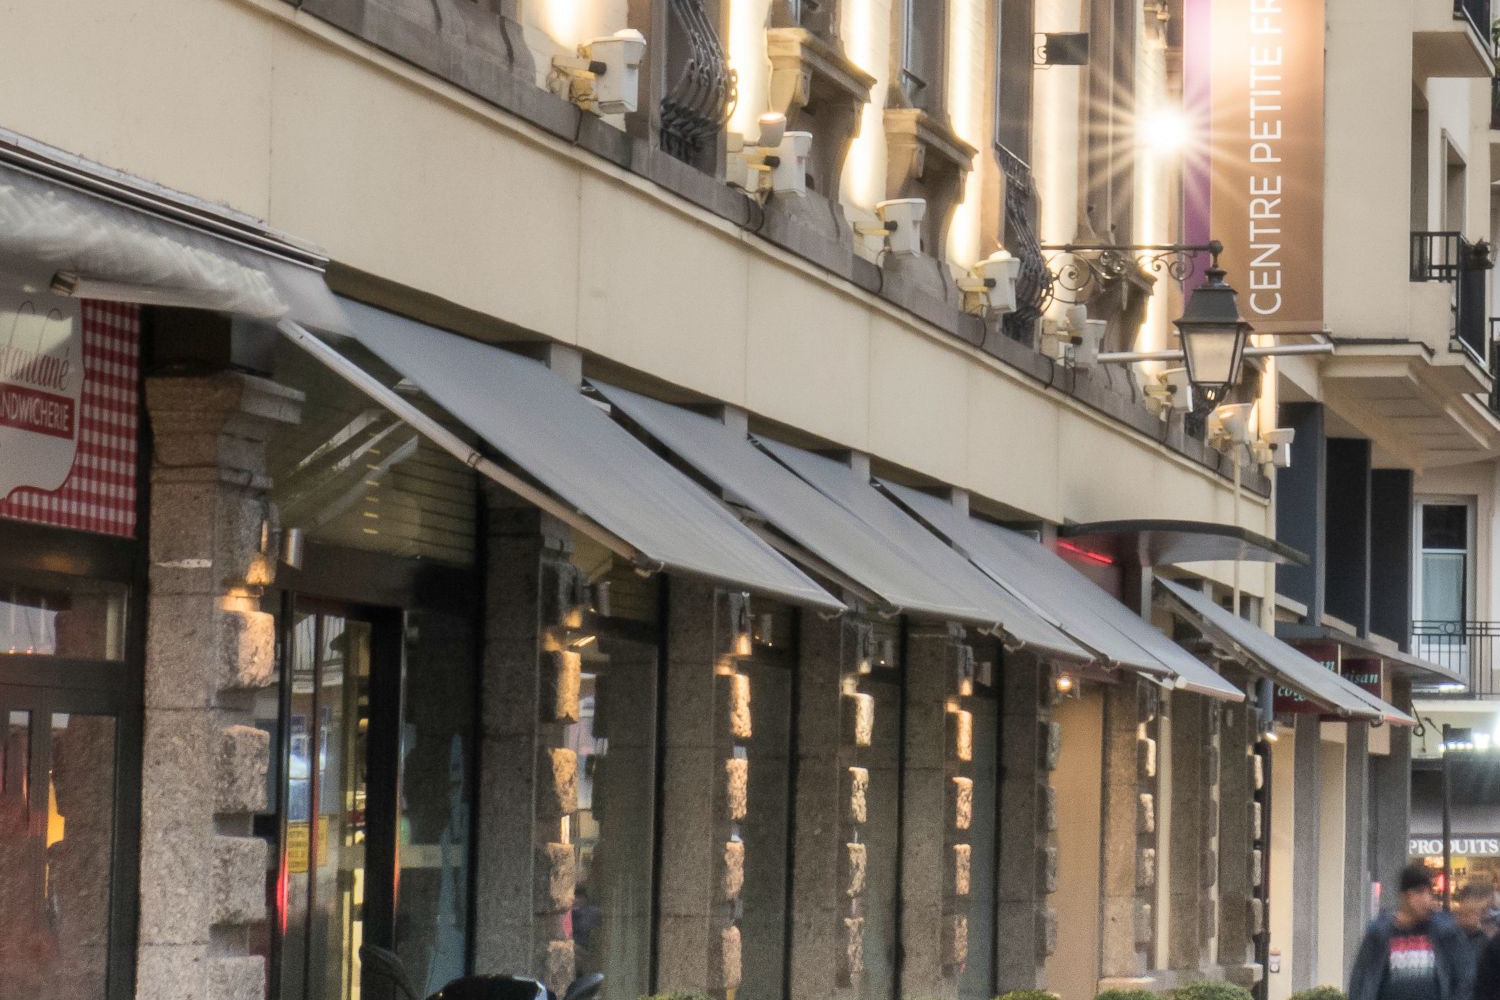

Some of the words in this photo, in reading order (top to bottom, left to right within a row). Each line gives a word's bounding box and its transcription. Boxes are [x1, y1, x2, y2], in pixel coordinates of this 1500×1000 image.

[1250, 46, 1282, 162] PETITE
[1249, 175, 1282, 316] CENTRE
[0, 391, 69, 431] NDWICHERIE
